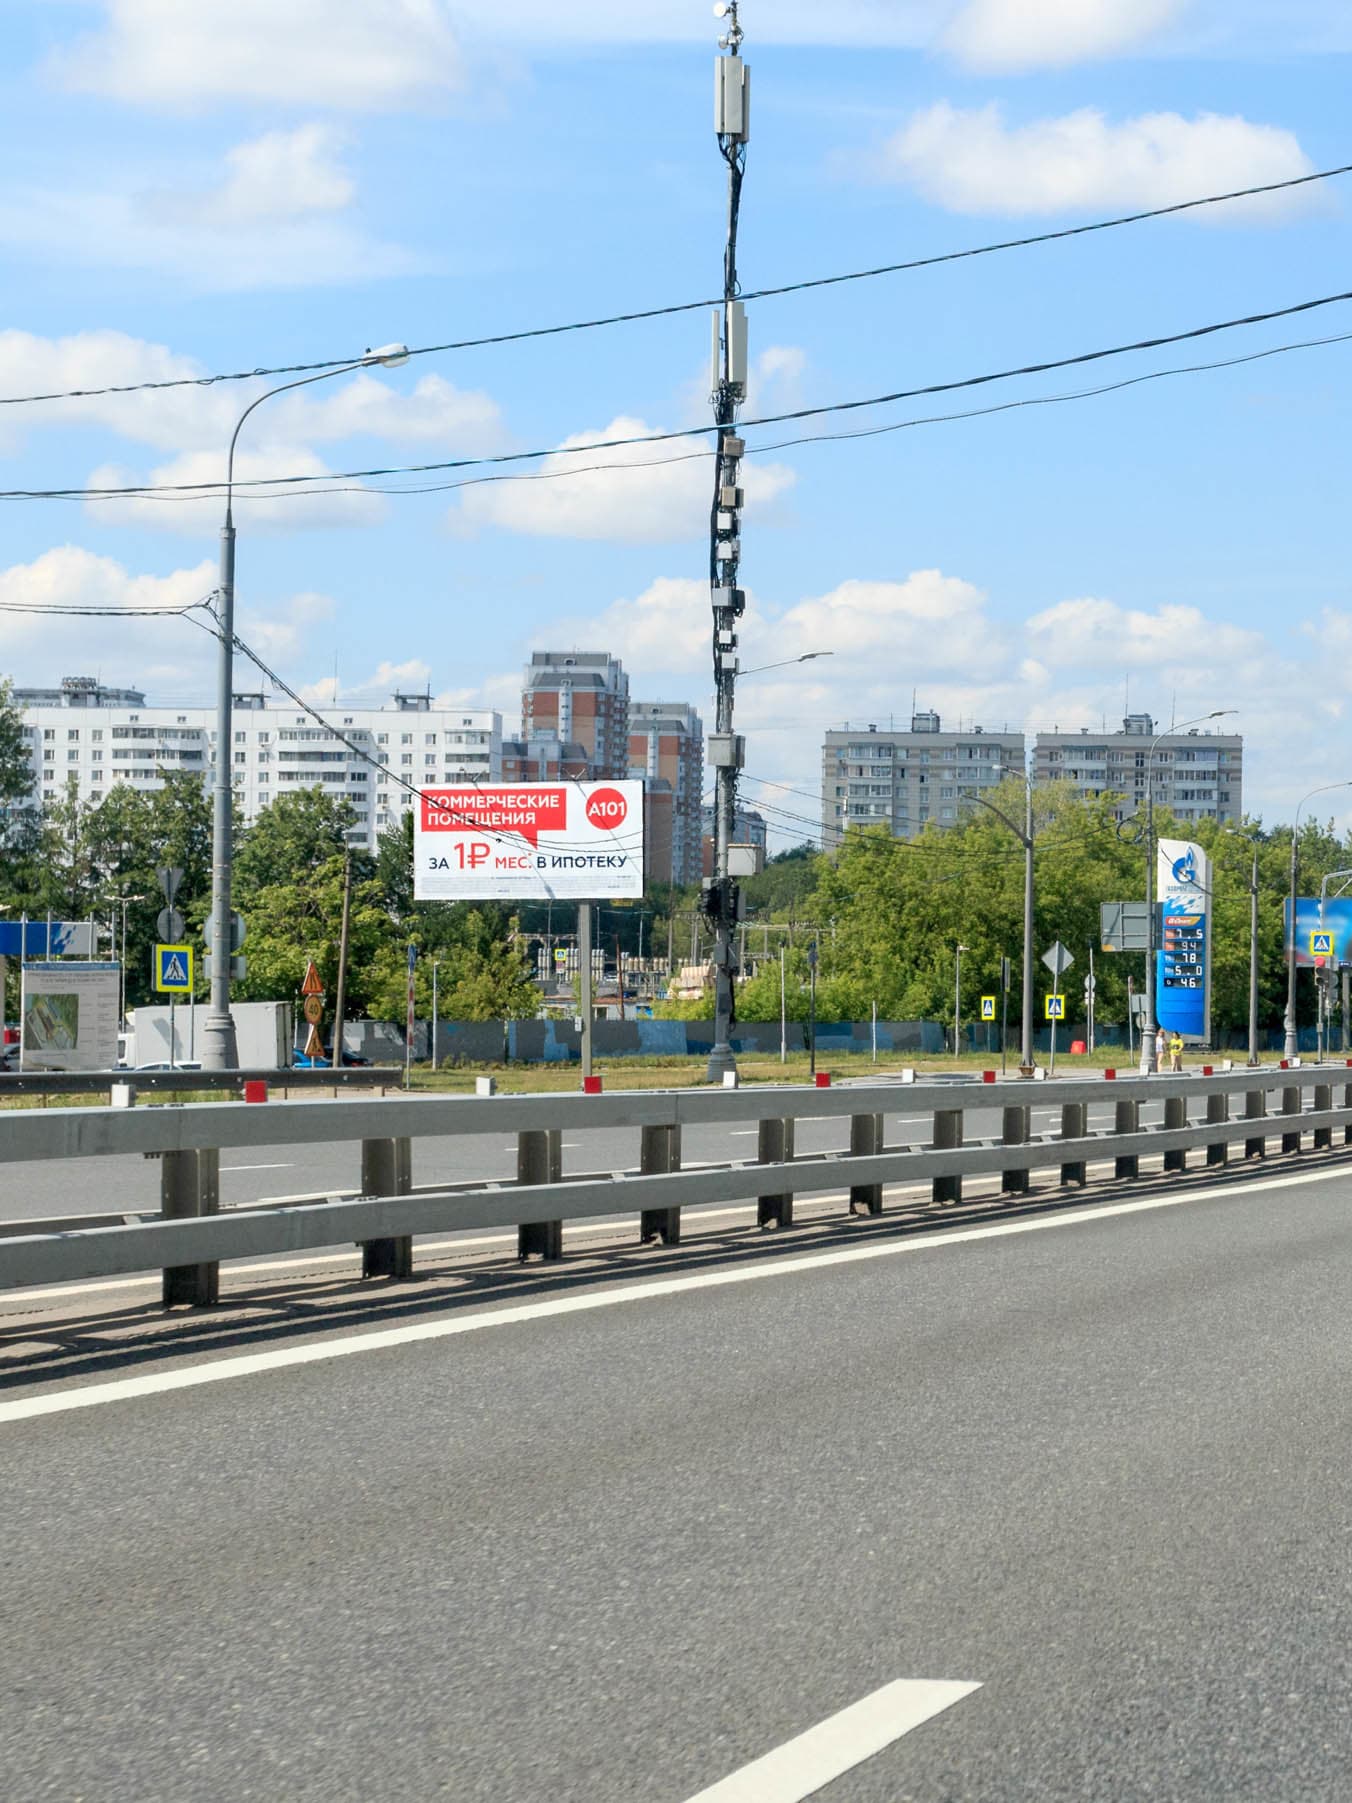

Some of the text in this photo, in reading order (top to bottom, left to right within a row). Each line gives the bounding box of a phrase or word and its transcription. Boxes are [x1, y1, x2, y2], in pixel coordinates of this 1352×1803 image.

[428, 795, 560, 809] КОММЕРЧЕСКИЕ
[427, 811, 537, 827] ПОМЕЩЕНИЯ
[428, 857, 450, 870] ЗА
[537, 856, 547, 869] В
[551, 855, 628, 869] ИПОТЕКУ
